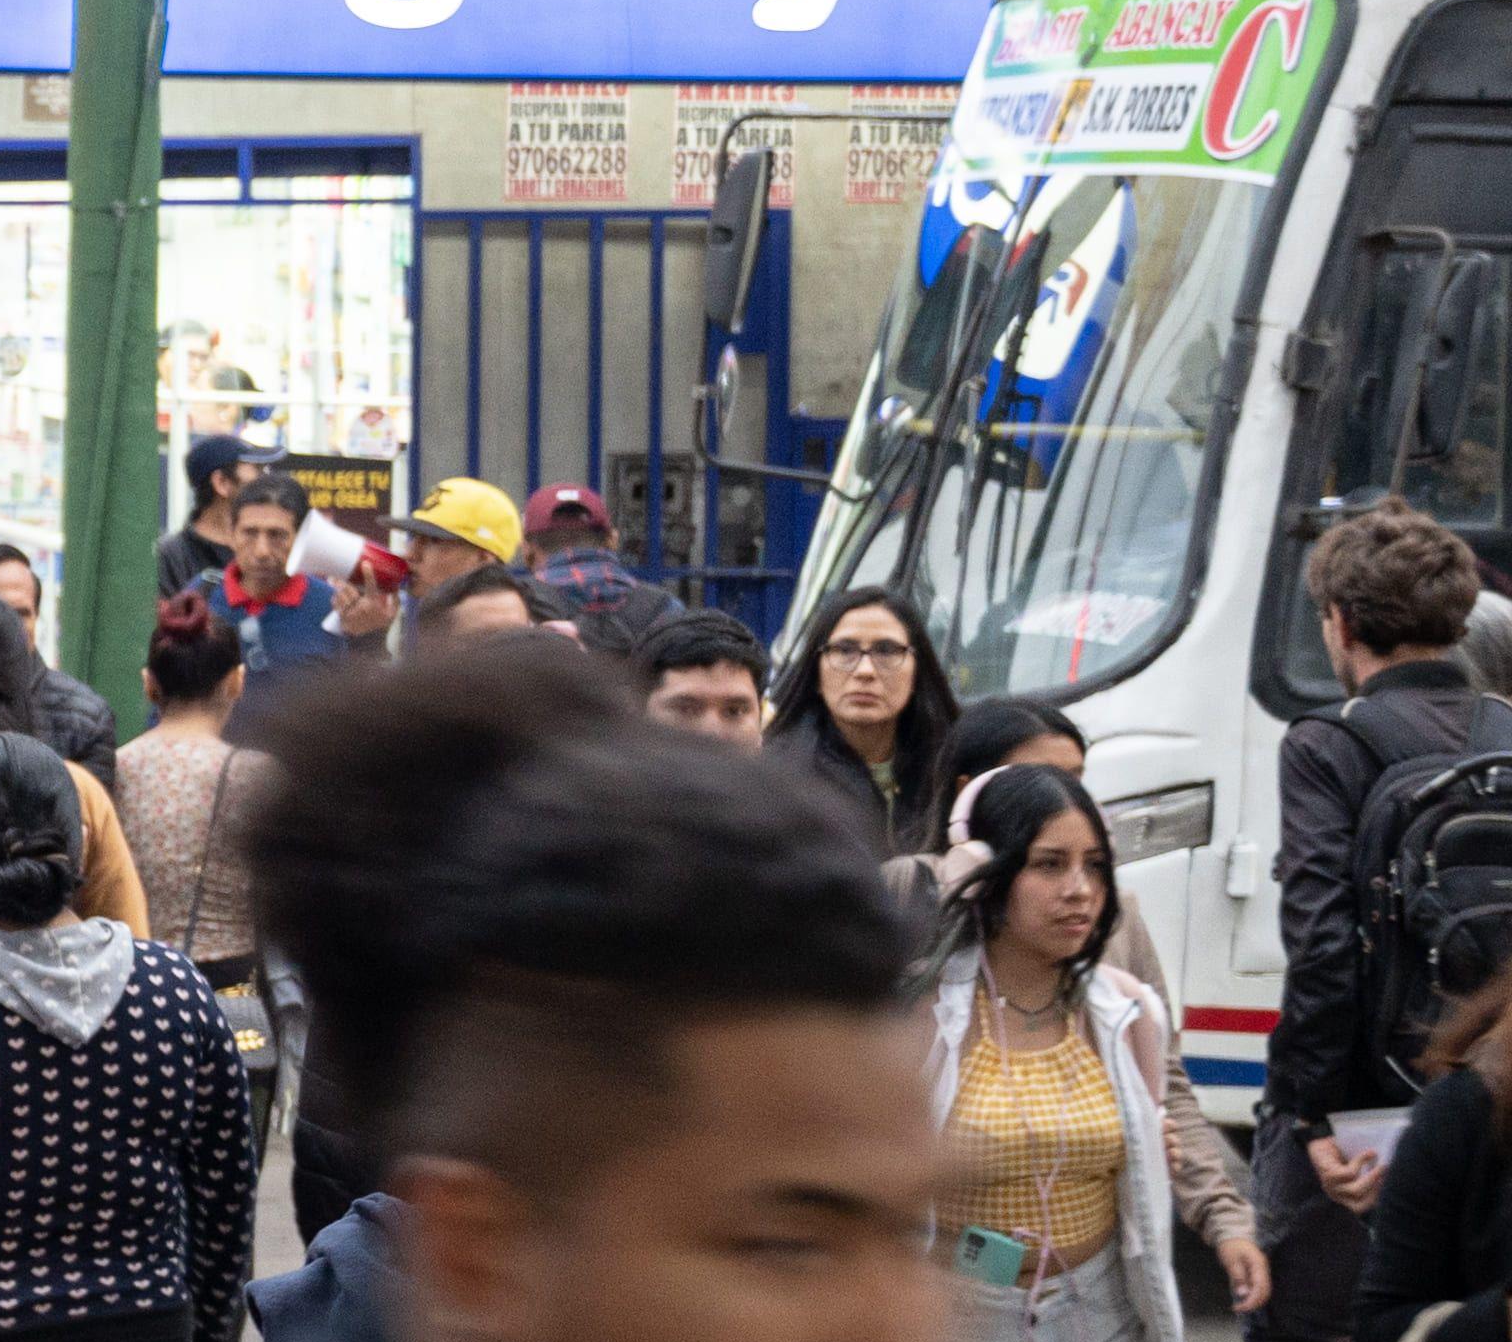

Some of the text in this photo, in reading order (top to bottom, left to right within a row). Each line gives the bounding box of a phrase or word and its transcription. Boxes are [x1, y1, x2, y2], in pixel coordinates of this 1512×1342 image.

[1119, 84, 1197, 135] PORRES
[509, 123, 626, 142] A TU PAREJA
[696, 127, 718, 146] TU
[870, 124, 891, 144] TU
[508, 146, 627, 175] 970662288
